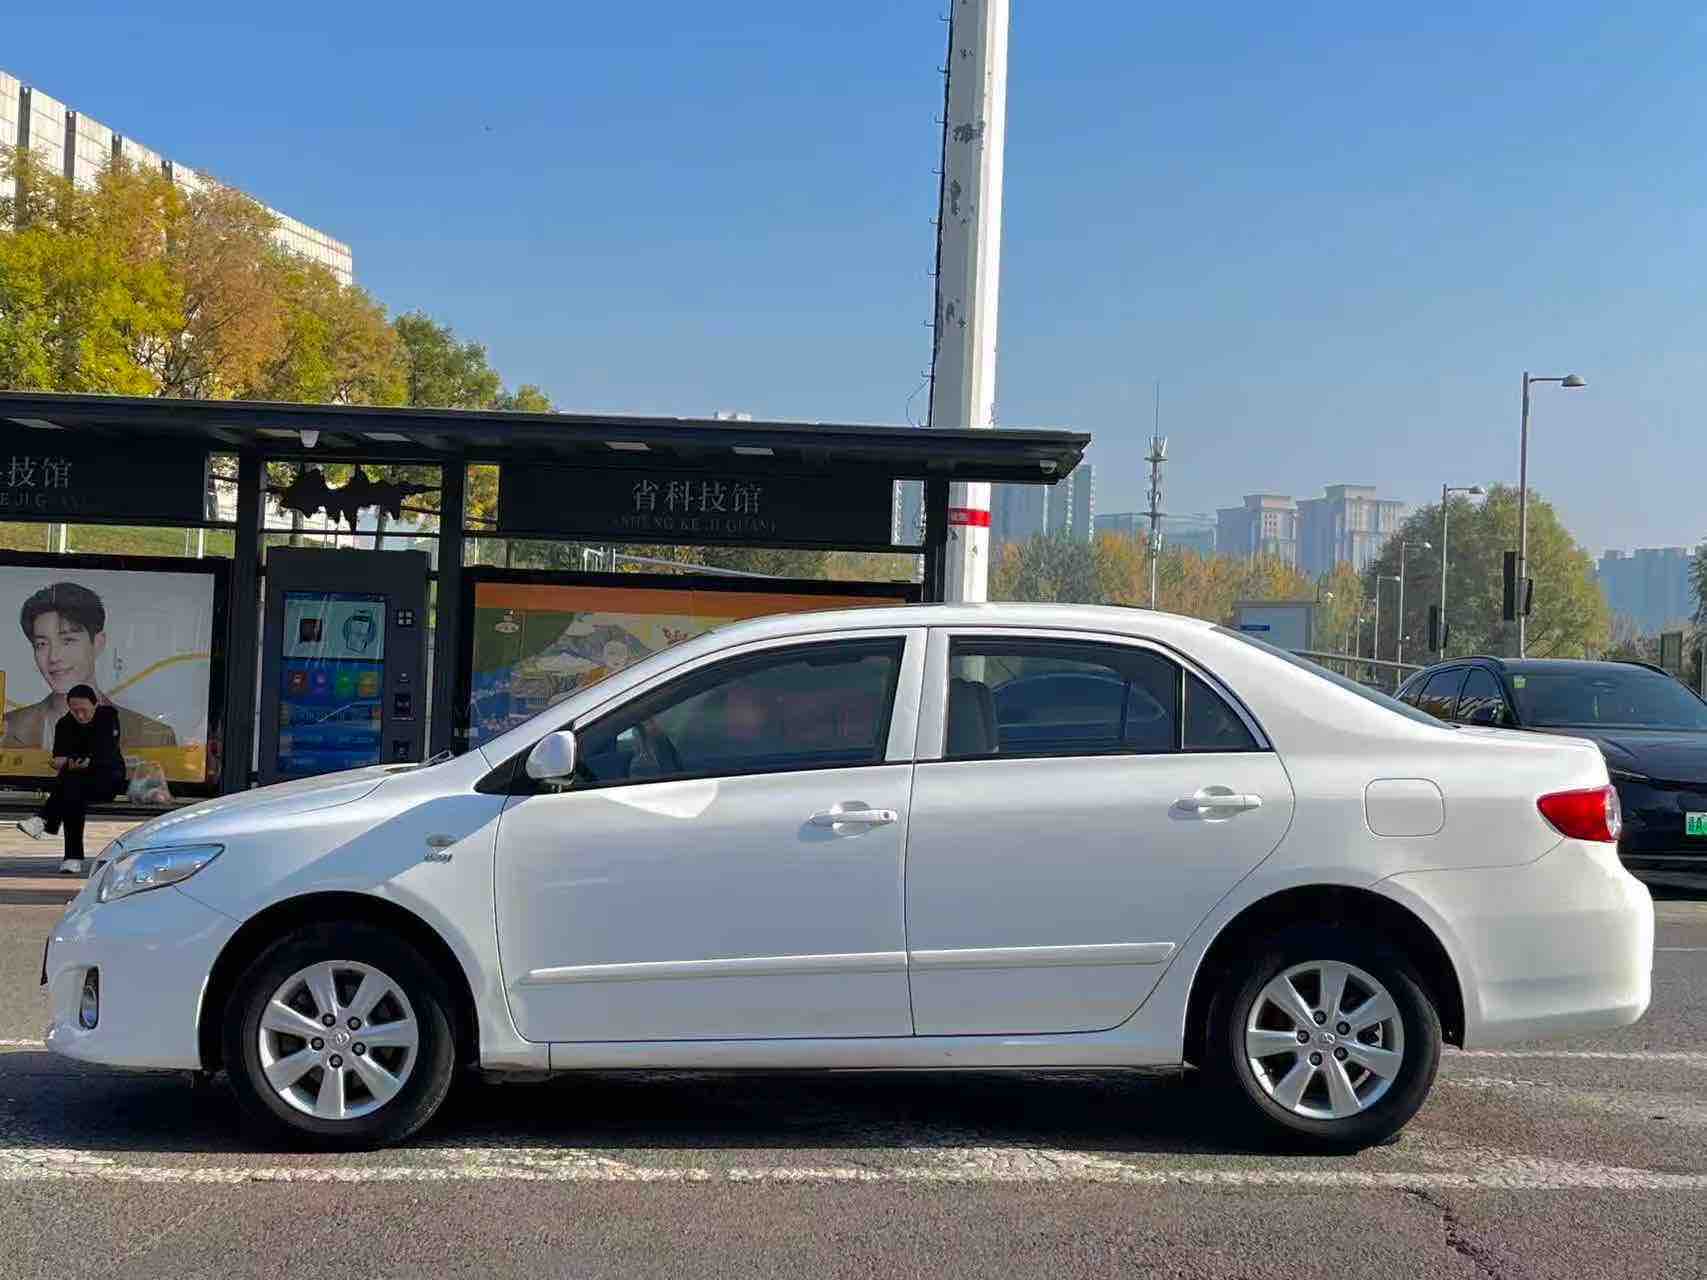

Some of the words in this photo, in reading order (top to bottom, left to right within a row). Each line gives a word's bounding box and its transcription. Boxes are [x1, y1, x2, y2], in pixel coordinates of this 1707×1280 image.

[0, 456, 73, 488] 技馆
[632, 480, 763, 514] 省科技馆
